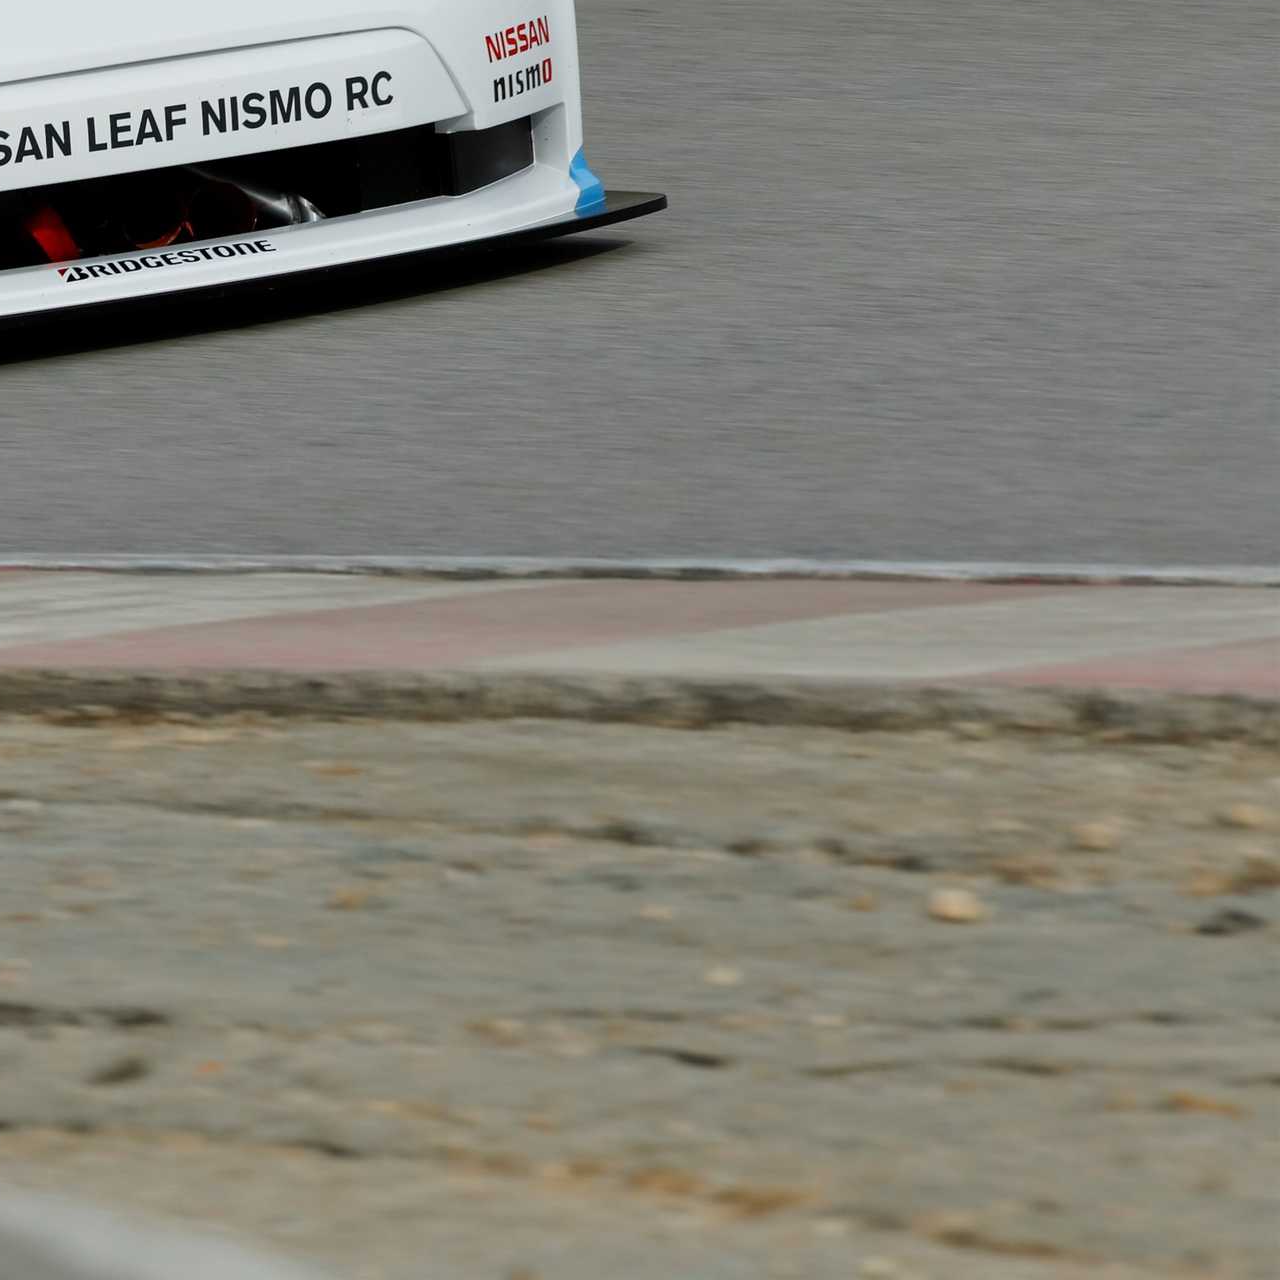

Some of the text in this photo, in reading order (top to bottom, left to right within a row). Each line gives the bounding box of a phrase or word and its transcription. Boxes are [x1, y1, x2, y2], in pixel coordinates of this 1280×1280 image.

[485, 16, 550, 63] NISSAN
[492, 57, 553, 103] nismo
[86, 103, 188, 153] LEAF
[200, 82, 332, 137] NISMO
[345, 71, 395, 111] RC
[58, 238, 276, 283] BRIDGESTONE
